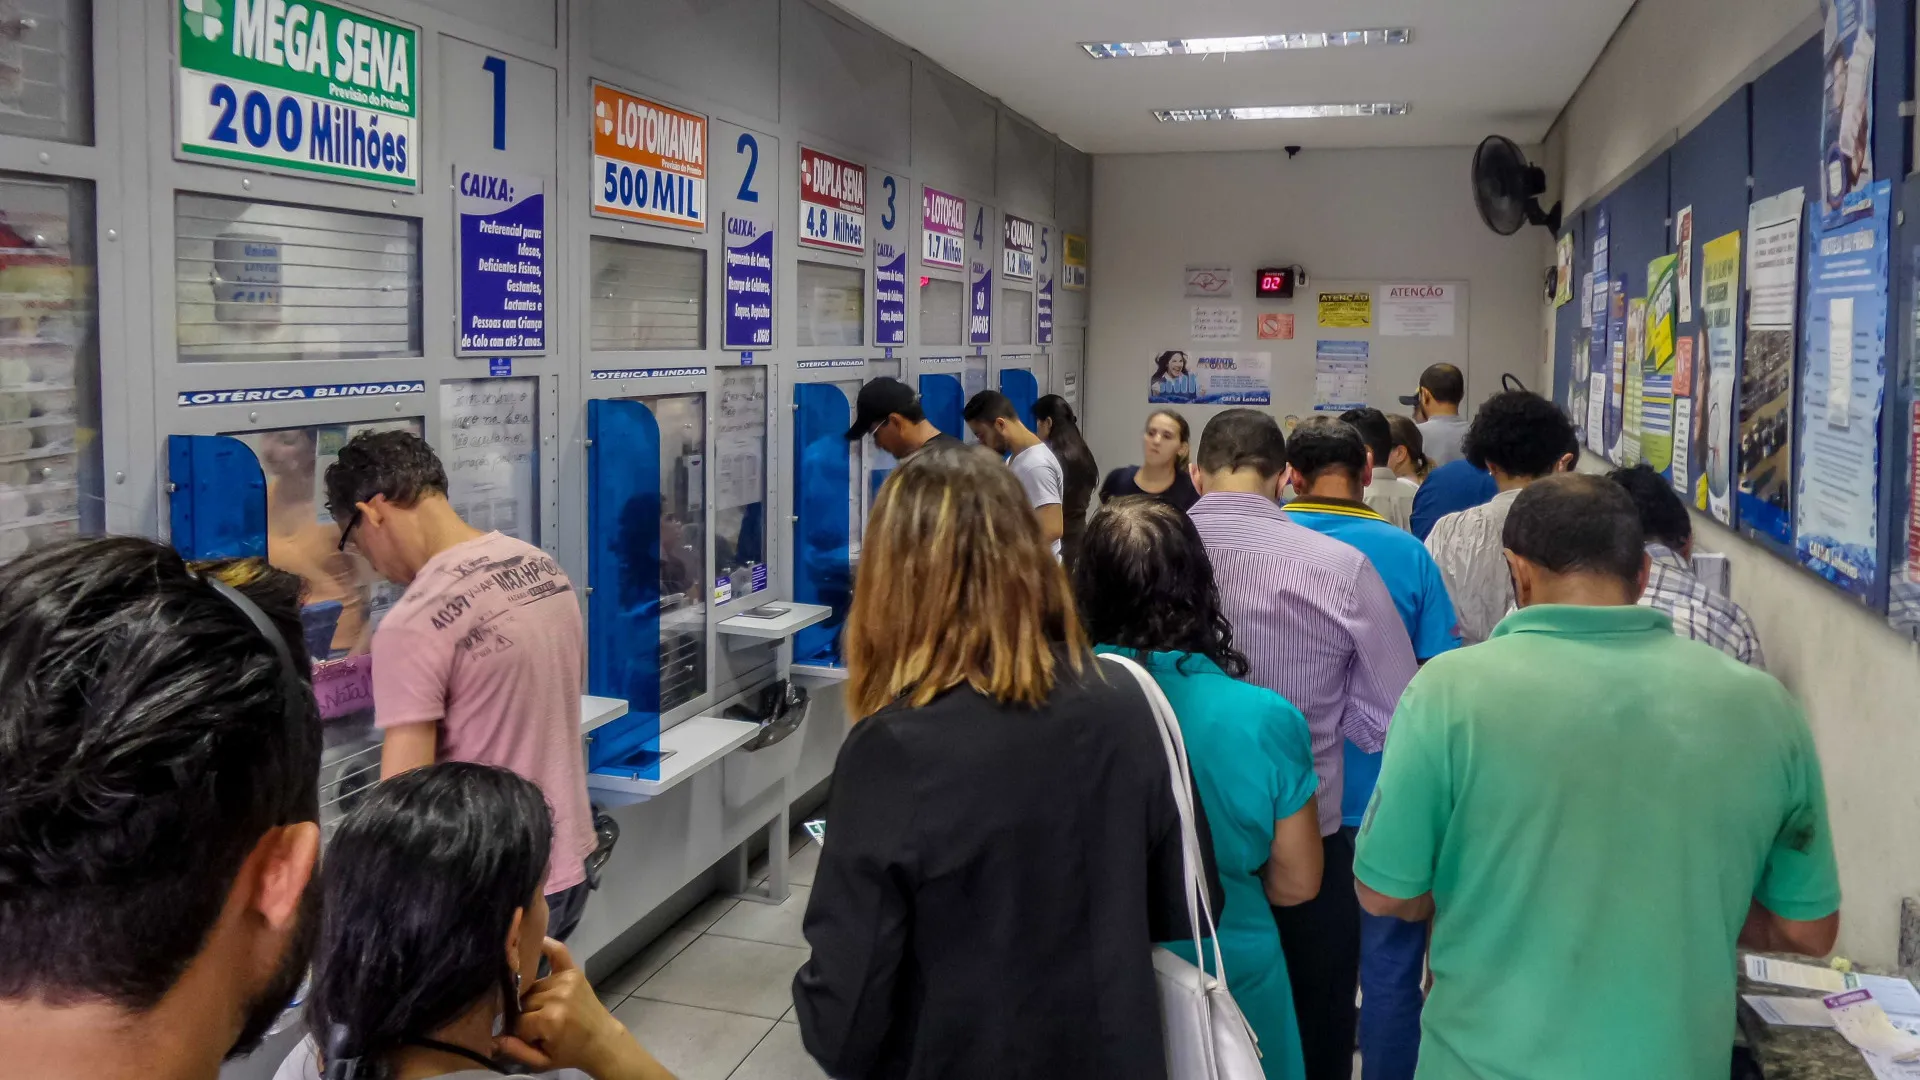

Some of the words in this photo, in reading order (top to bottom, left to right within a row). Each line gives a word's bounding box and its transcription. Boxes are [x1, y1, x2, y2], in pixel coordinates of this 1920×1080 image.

[232, 0, 330, 77] MEGA
[335, 18, 410, 97] SENA
[329, 82, 368, 103] Previsão
[369, 91, 380, 106] do
[482, 55, 506, 151] 1
[208, 83, 302, 152] 200
[309, 101, 407, 174] Milhões
[617, 98, 702, 165] LOTOMANIA
[736, 132, 759, 203] 2
[460, 171, 514, 203] CAIXA:
[604, 161, 648, 208] 500
[652, 170, 699, 219] MIL
[813, 157, 841, 199] DUPLA
[842, 166, 863, 205] SENA
[881, 175, 896, 231] 3
[479, 220, 523, 238] Preferencial
[522, 227, 542, 242] para:
[727, 217, 757, 238] CAIXA:
[806, 206, 828, 238] 4.8
[973, 206, 983, 250] 4
[1010, 219, 1033, 249] QUINA
[517, 243, 542, 259] Idosos,
[928, 233, 941, 258] 1.7
[1040, 227, 1048, 264] 5
[478, 258, 517, 274] Deficientes
[506, 279, 542, 296] Gestantes,
[1261, 276, 1281, 290] 02
[1390, 285, 1444, 299] ATENÇÃO
[504, 297, 536, 311] Lactantes
[536, 302, 542, 311] e
[472, 315, 501, 329] Pessoas
[502, 318, 517, 329] com
[517, 316, 543, 333] Criança
[461, 333, 471, 347] de
[472, 334, 488, 348] Colo
[489, 338, 504, 348] com
[517, 335, 523, 347] 2
[651, 367, 707, 378] BLINDADA
[178, 388, 306, 405] LOTÉRICA
[313, 383, 425, 398] BLINDADA
